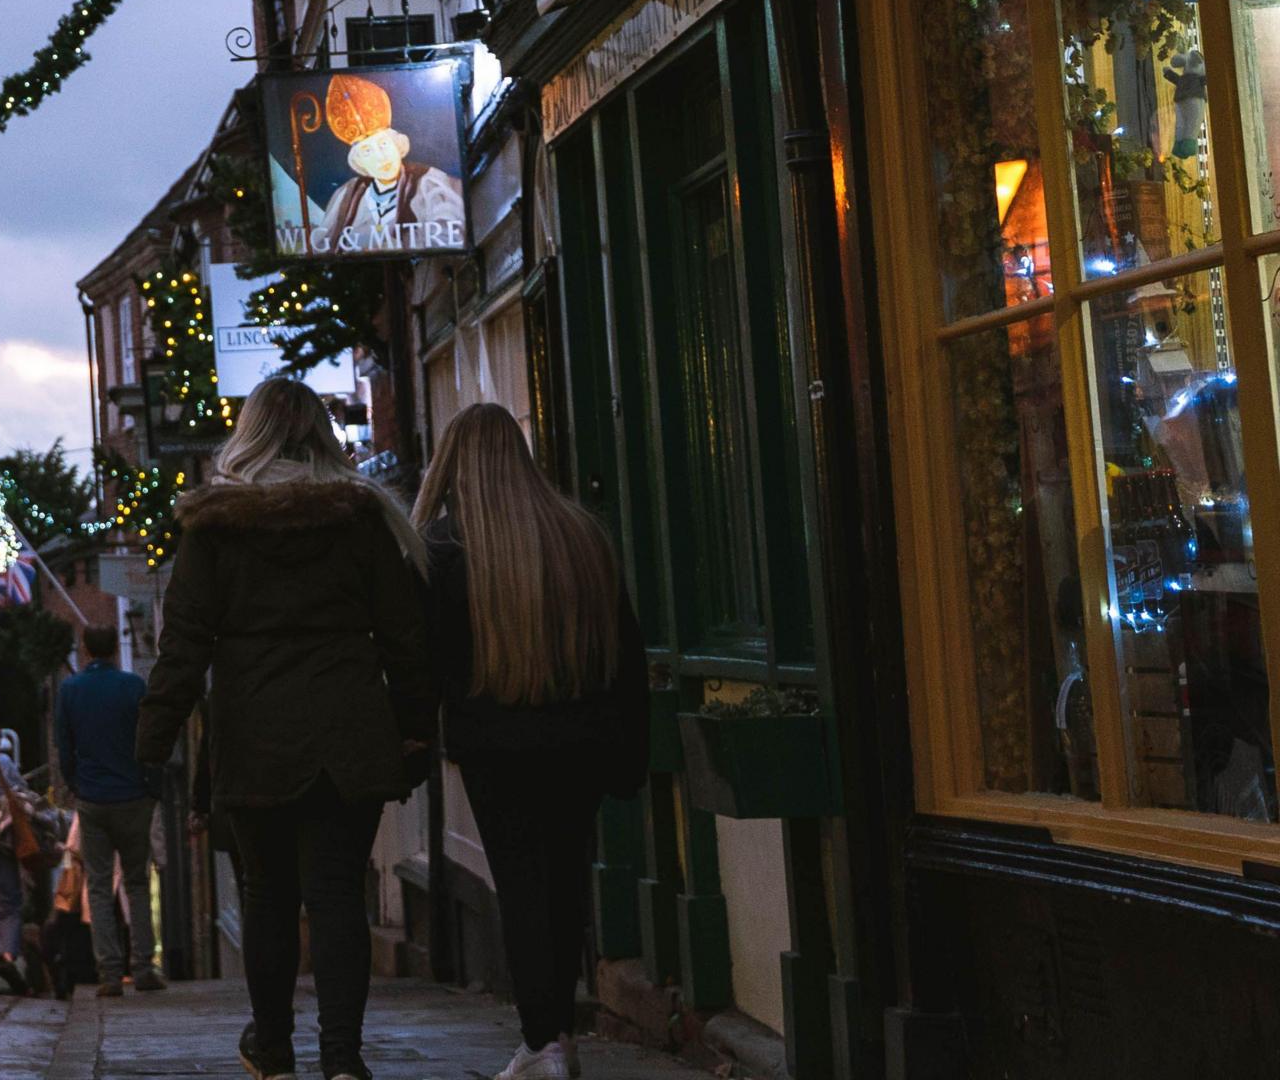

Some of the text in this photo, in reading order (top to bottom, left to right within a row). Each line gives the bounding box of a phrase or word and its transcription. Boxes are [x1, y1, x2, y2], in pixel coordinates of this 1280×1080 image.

[276, 220, 464, 255] WIG & MITRE
